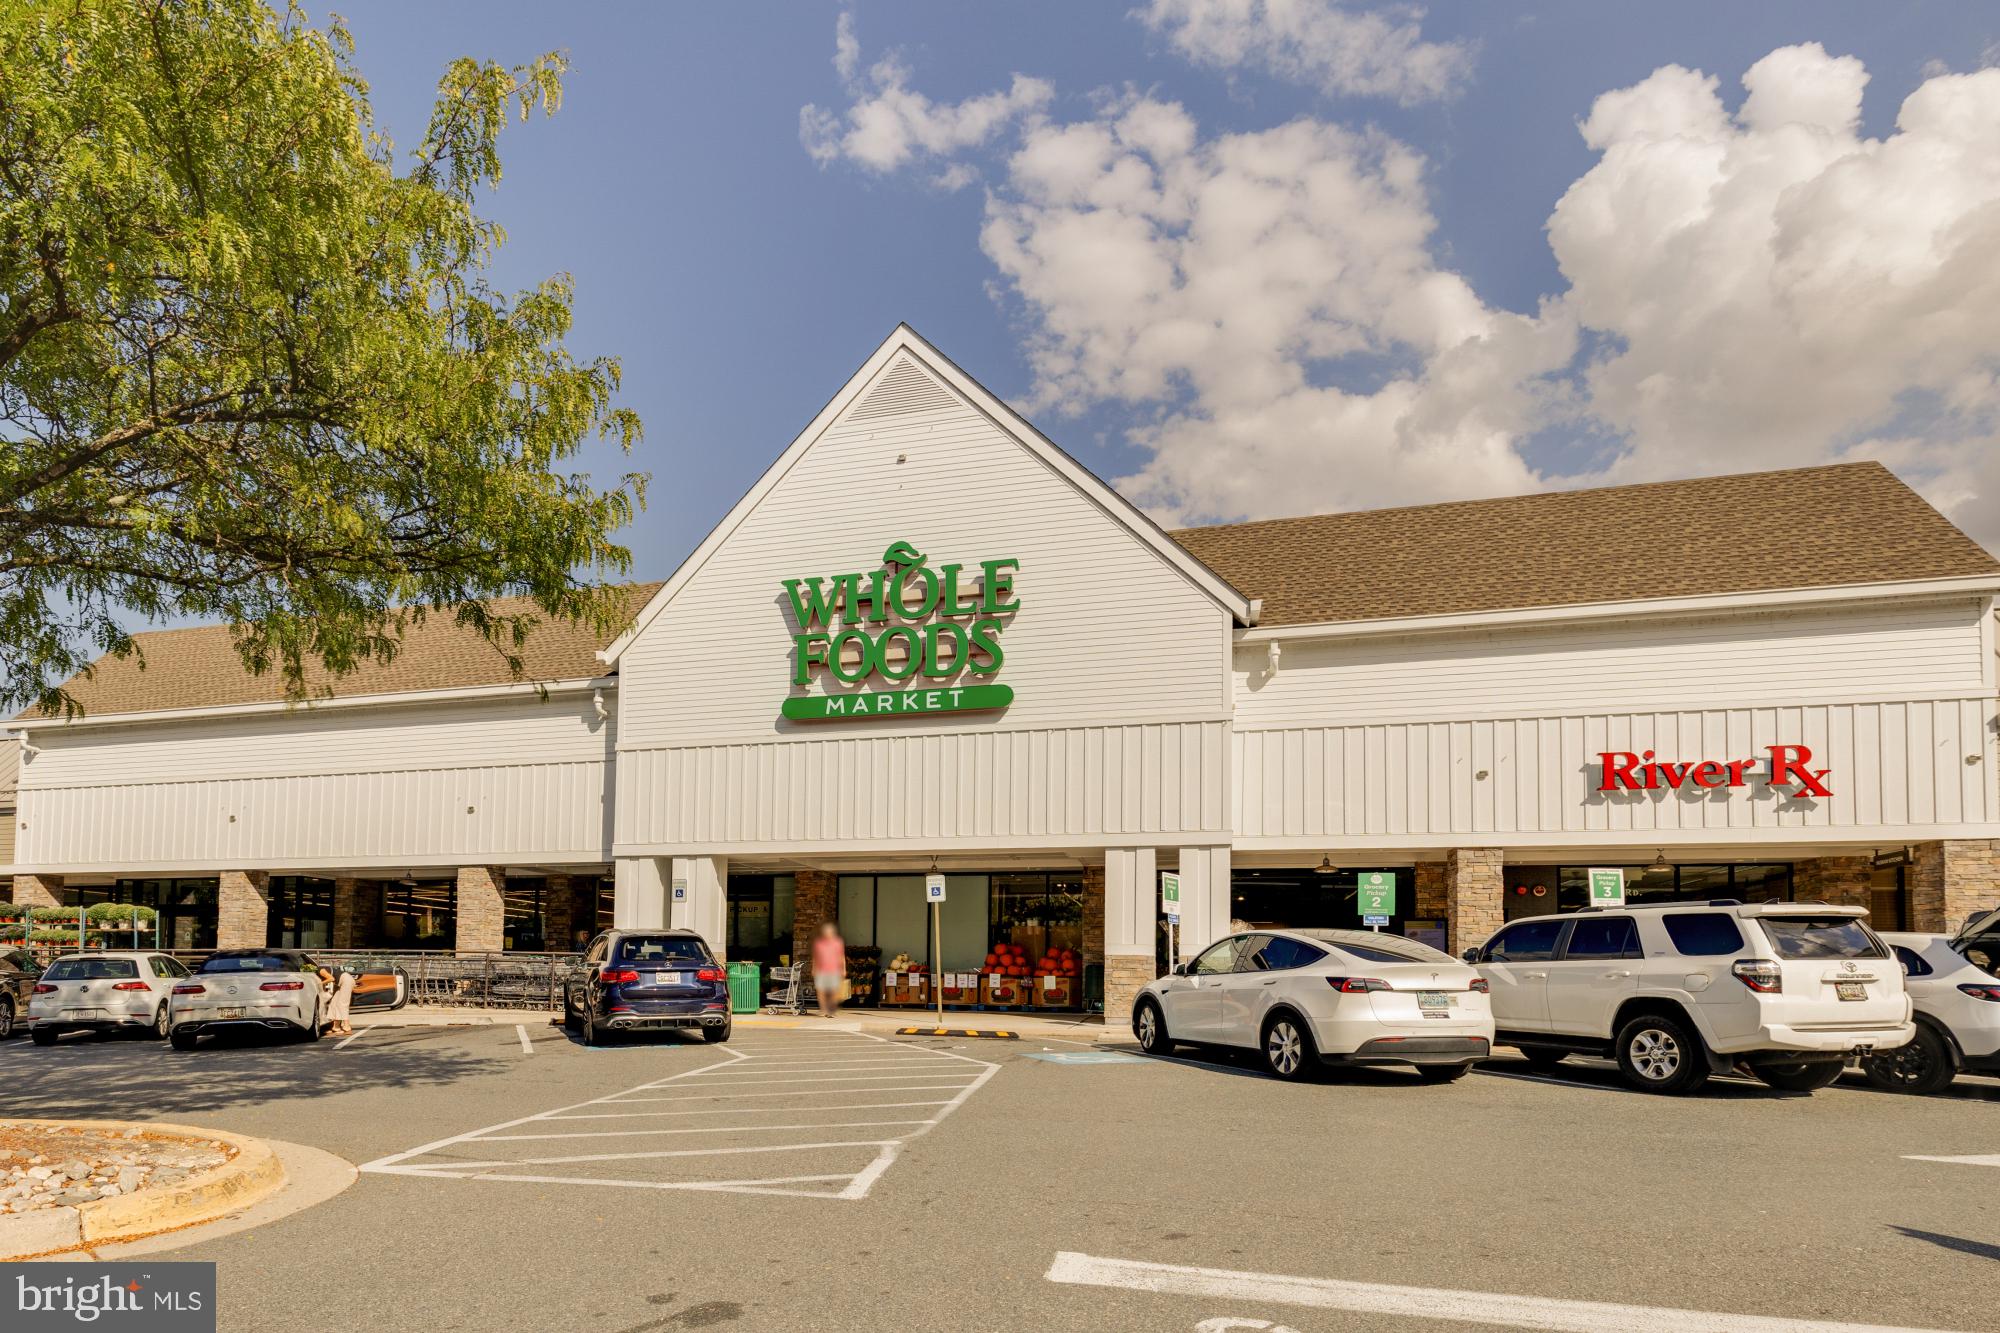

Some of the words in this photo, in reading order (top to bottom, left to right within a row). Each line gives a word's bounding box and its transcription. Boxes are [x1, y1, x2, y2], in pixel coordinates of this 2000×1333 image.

[781, 553, 1020, 627] WHOLE
[793, 619, 1004, 685] FOODS
[825, 689, 964, 715] MARKET
[1596, 749, 1756, 791] River
[1763, 744, 1834, 797] Rx
[1372, 897, 1381, 907] 2
[1603, 886, 1611, 897] 3
